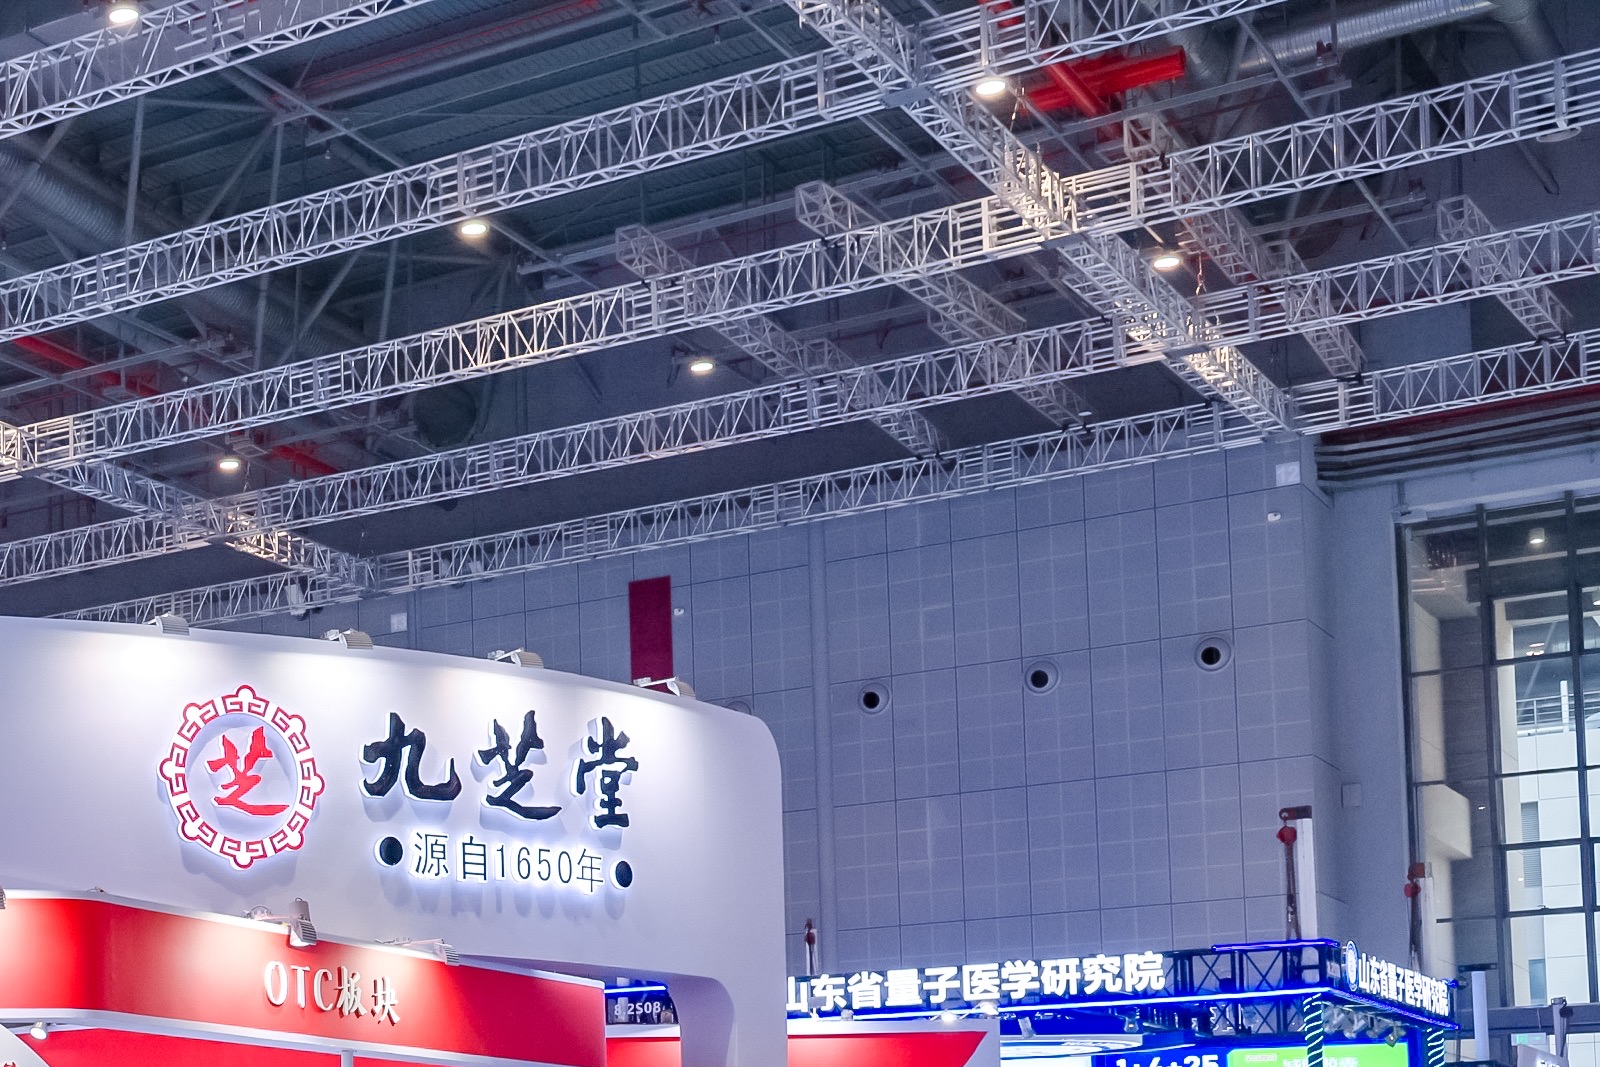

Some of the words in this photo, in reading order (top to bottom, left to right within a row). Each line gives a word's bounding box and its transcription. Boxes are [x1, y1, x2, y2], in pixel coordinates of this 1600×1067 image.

[358, 709, 639, 829] 九芝堂
[412, 830, 606, 894] 源自1650年
[263, 960, 401, 1026] OTC板块
[786, 951, 1166, 1013] 山东省量子医学研究院
[1358, 953, 1449, 1016] 山东省量子医学研究院
